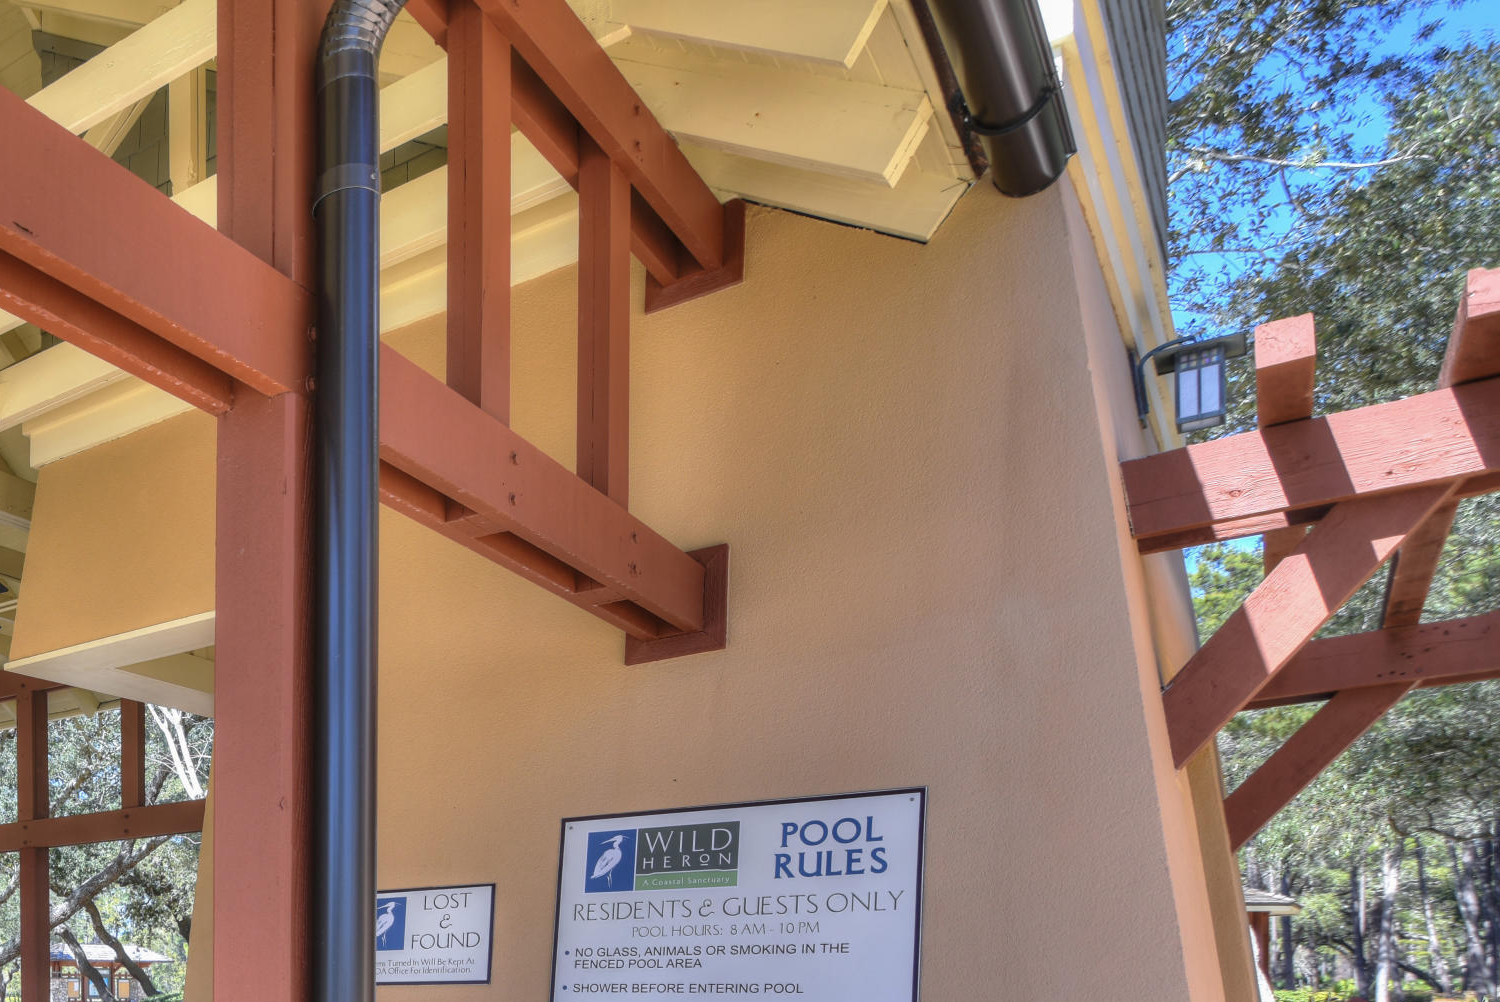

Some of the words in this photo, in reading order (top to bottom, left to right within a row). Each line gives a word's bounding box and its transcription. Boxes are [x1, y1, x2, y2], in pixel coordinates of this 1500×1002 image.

[645, 828, 733, 854] WILD
[781, 816, 883, 848] POOL
[642, 852, 731, 870] HERON
[773, 847, 888, 879] RULES
[643, 879, 649, 887] A
[652, 876, 684, 886] Coastal
[423, 893, 472, 911] LOST
[573, 899, 692, 921] RESIDENTS
[698, 899, 715, 917] &
[722, 894, 819, 917] GUESTS
[826, 890, 904, 913] ONLY
[439, 913, 453, 929] &
[631, 926, 668, 938] POOL
[671, 924, 723, 937] HOURS:
[730, 924, 738, 935] 8
[741, 923, 766, 935] AM
[780, 922, 795, 934] 10
[798, 921, 820, 934] PM
[411, 932, 481, 950] FOUND
[575, 947, 593, 958] NO
[596, 947, 641, 958] GLASS,
[644, 945, 702, 957] ANIMALS
[705, 945, 726, 956] OR
[730, 944, 797, 955] SMOKING
[801, 943, 816, 954] IN
[820, 942, 850, 954] THE
[574, 959, 625, 969] FENCED
[628, 958, 663, 969] POOL
[666, 958, 702, 969] AREA
[572, 983, 628, 993] SHOWER
[631, 983, 685, 994] BEFORE
[688, 983, 760, 994] ENTERING
[764, 983, 804, 994] POOL
